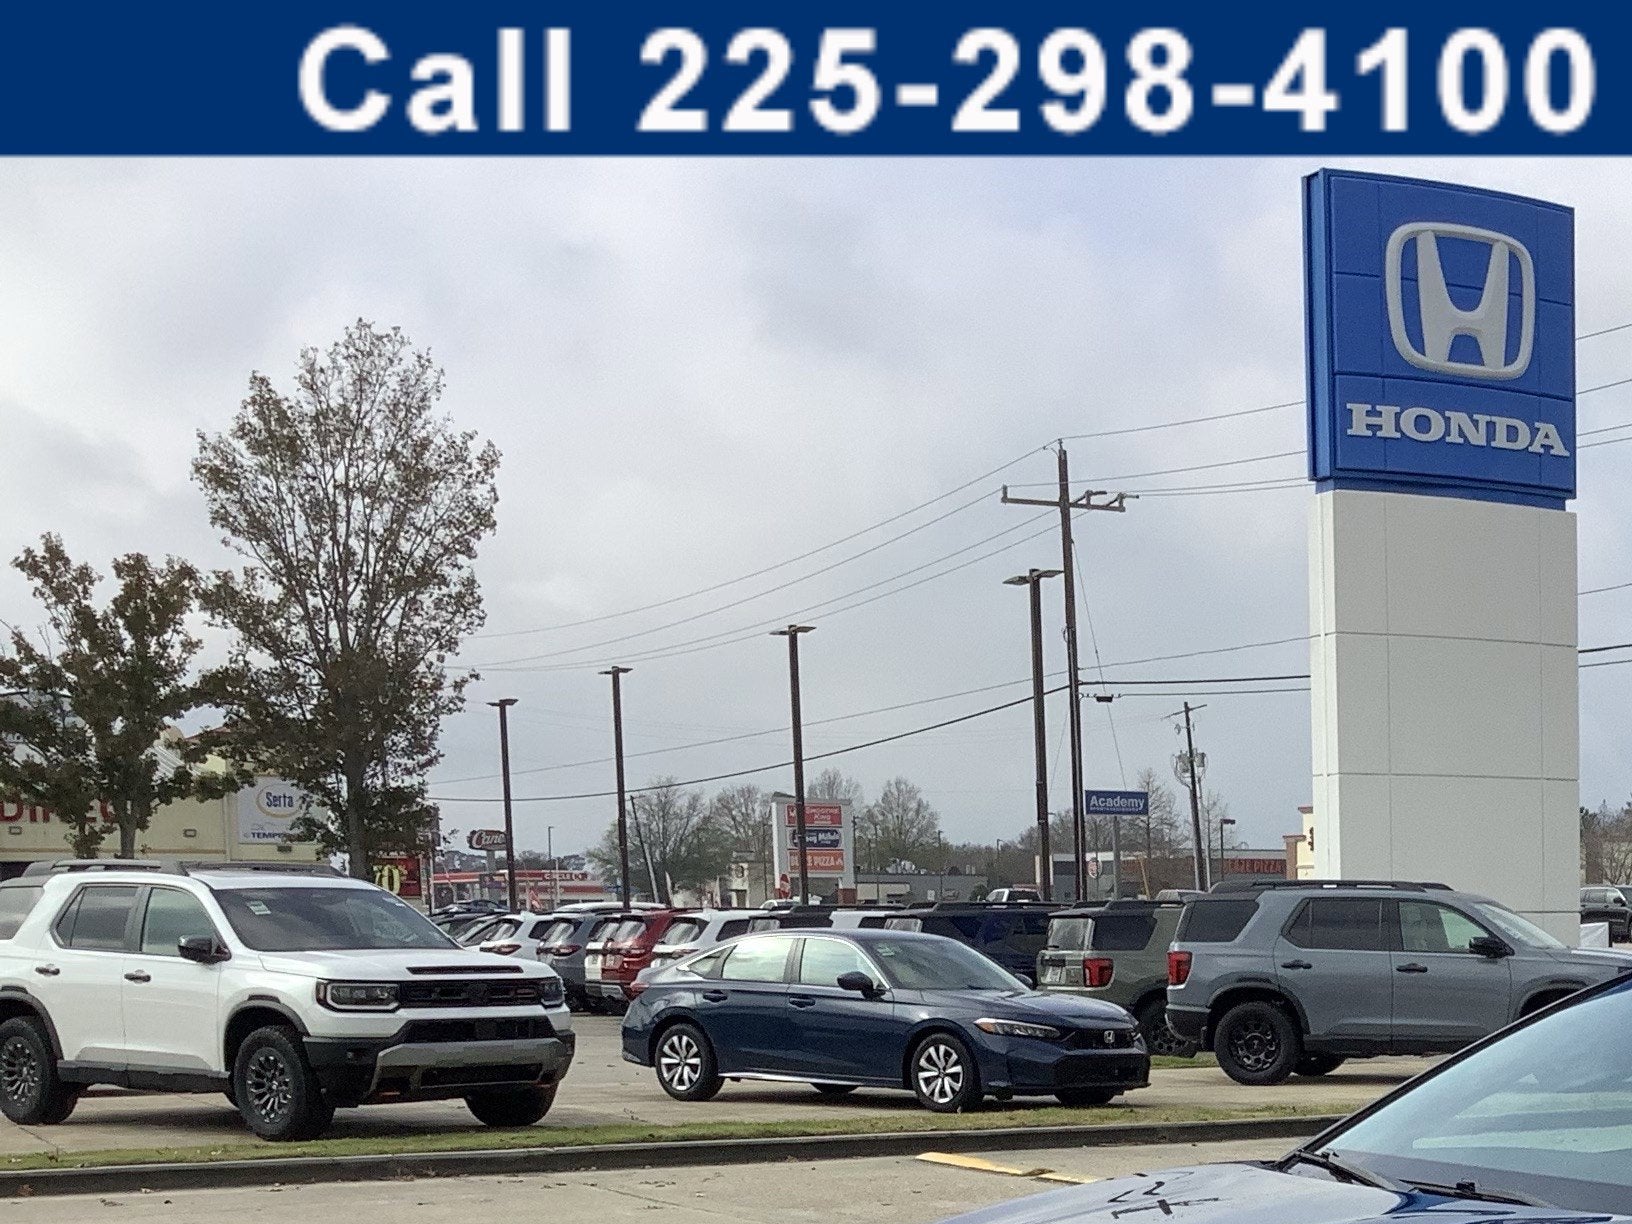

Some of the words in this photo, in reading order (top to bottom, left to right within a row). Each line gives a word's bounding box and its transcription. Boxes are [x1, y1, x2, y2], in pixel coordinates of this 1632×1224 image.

[1346, 402, 1570, 457] HONDA
[265, 791, 294, 808] Serta
[1089, 795, 1145, 810] Academy
